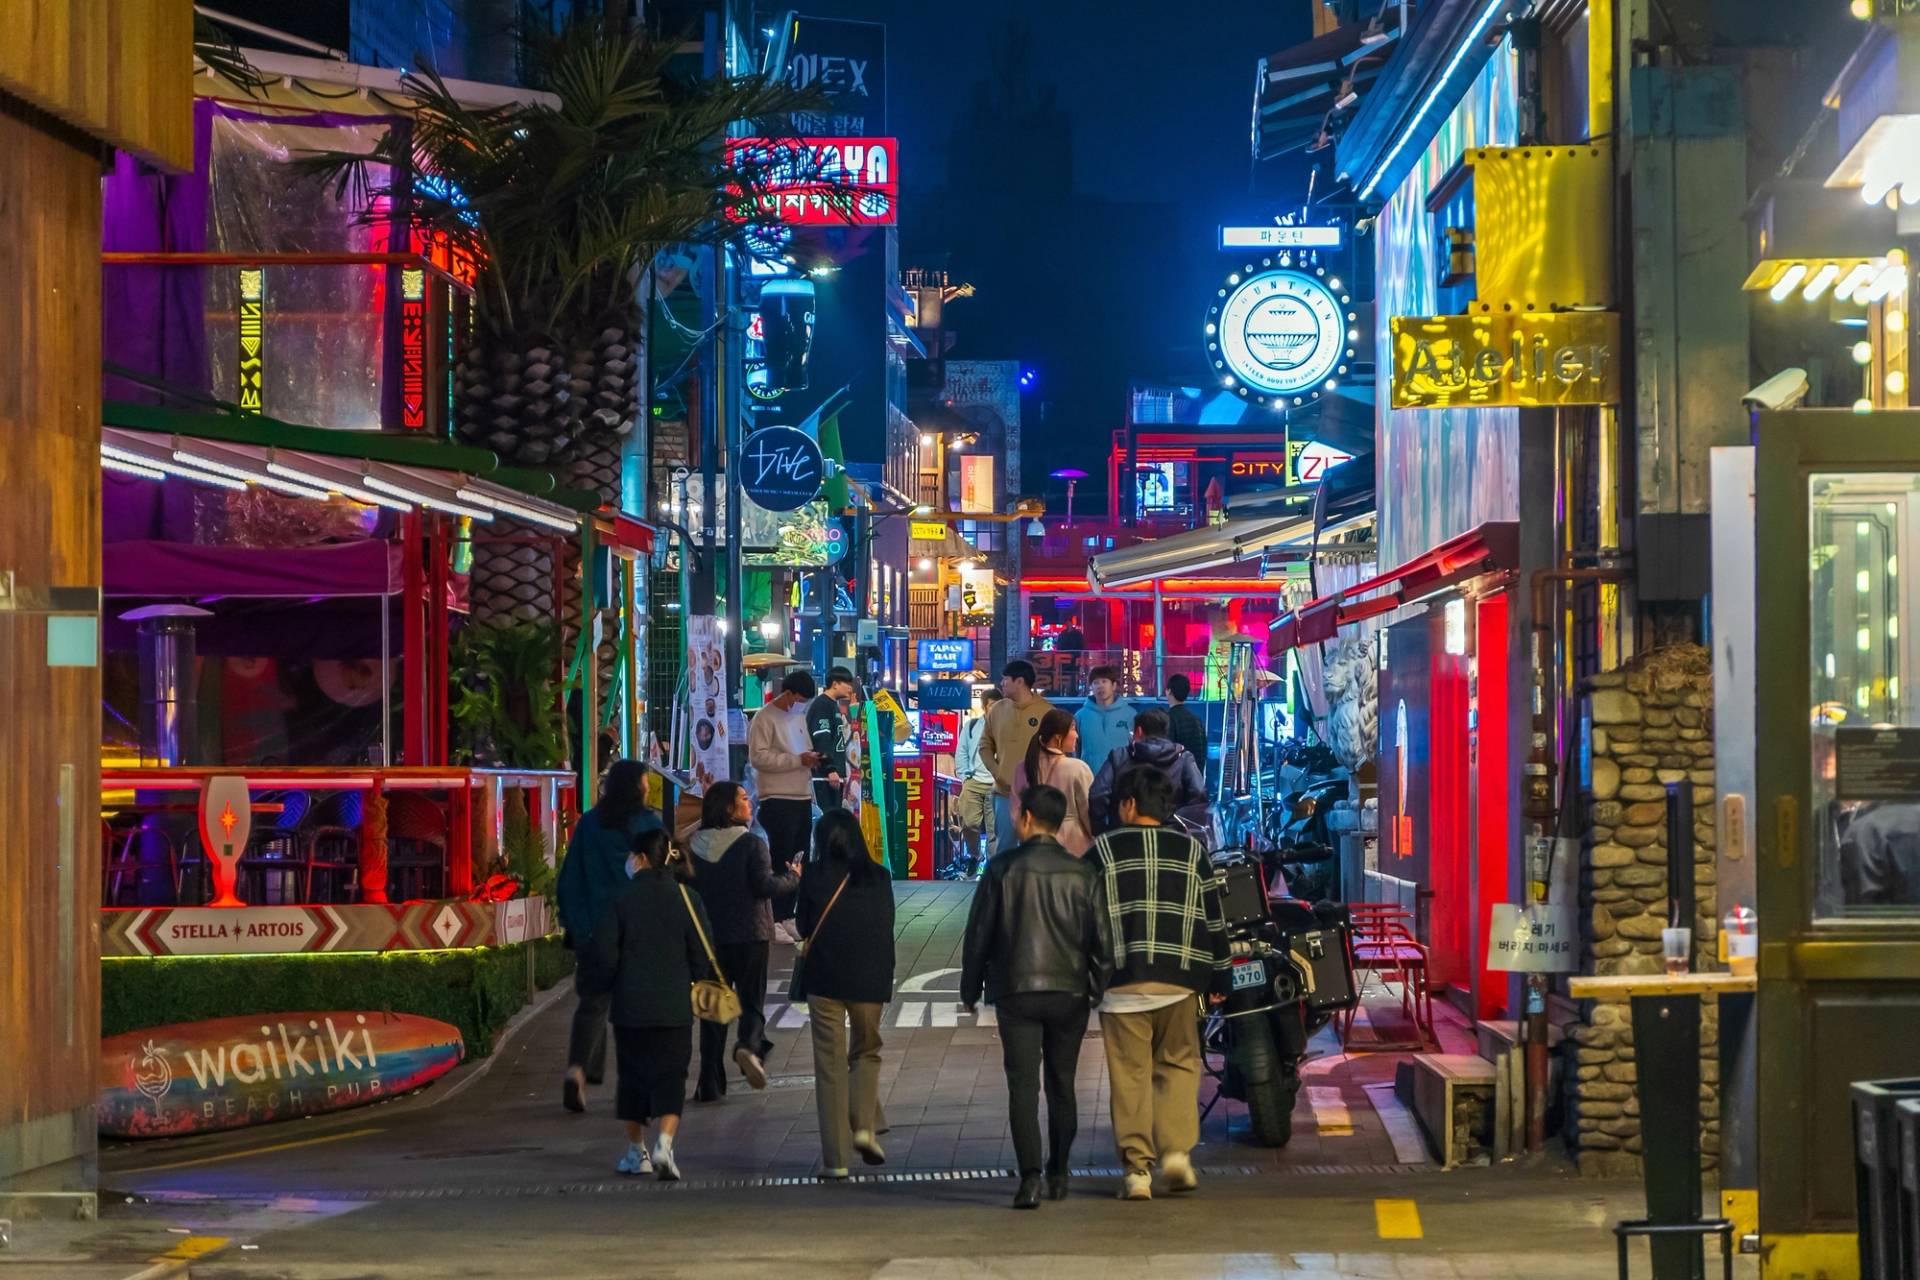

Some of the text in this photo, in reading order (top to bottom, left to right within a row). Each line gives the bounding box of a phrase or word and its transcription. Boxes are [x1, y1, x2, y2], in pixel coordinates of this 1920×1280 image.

[1403, 333, 1611, 385] Atelier
[1232, 463, 1283, 475] CITY
[1303, 456, 1352, 480] ZI
[928, 644, 962, 652] TAPAS
[934, 653, 957, 661] BAR
[927, 686, 963, 697] MEIN
[171, 921, 304, 940] STELLA ARTOIS
[1538, 941, 1570, 953] 마세요
[184, 1014, 378, 1091] waikiki
[202, 1089, 303, 1119] BEACH
